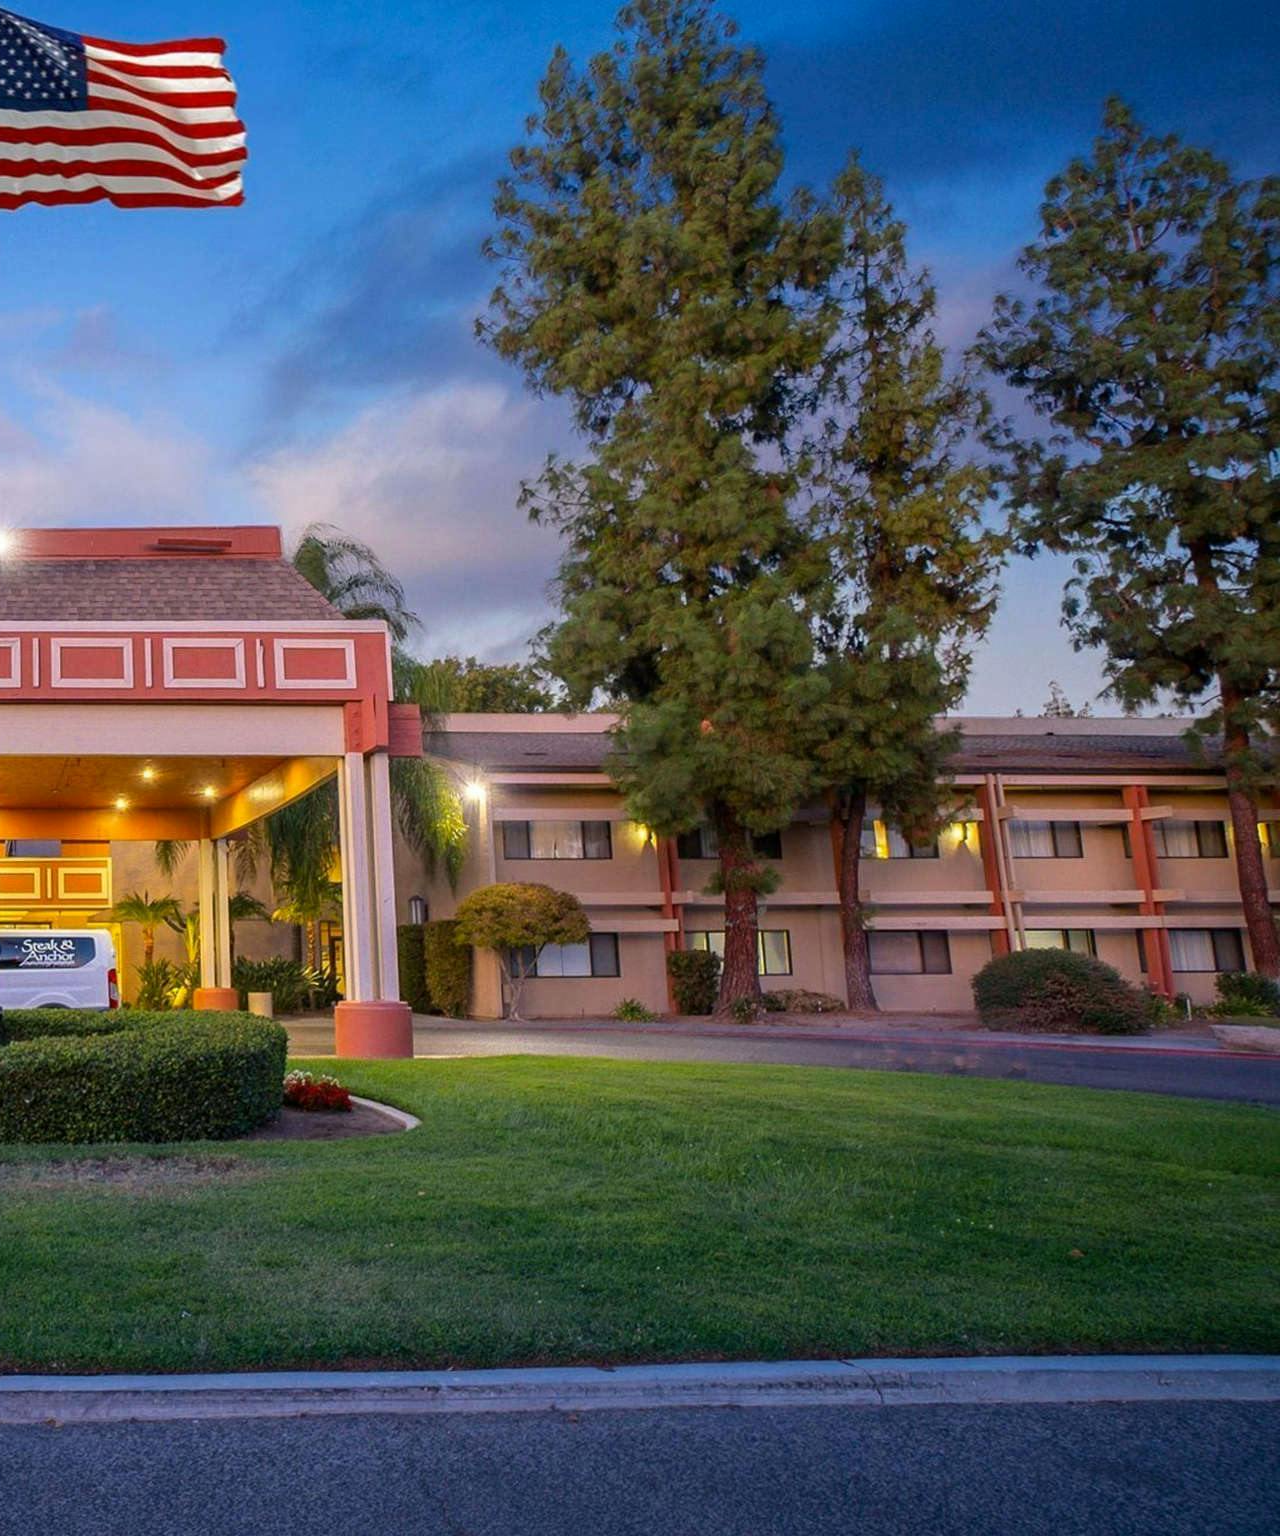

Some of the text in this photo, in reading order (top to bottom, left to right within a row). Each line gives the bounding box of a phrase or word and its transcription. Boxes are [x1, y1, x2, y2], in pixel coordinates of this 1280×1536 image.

[21, 939, 76, 953] Steak &
[19, 950, 75, 966] Anchor
